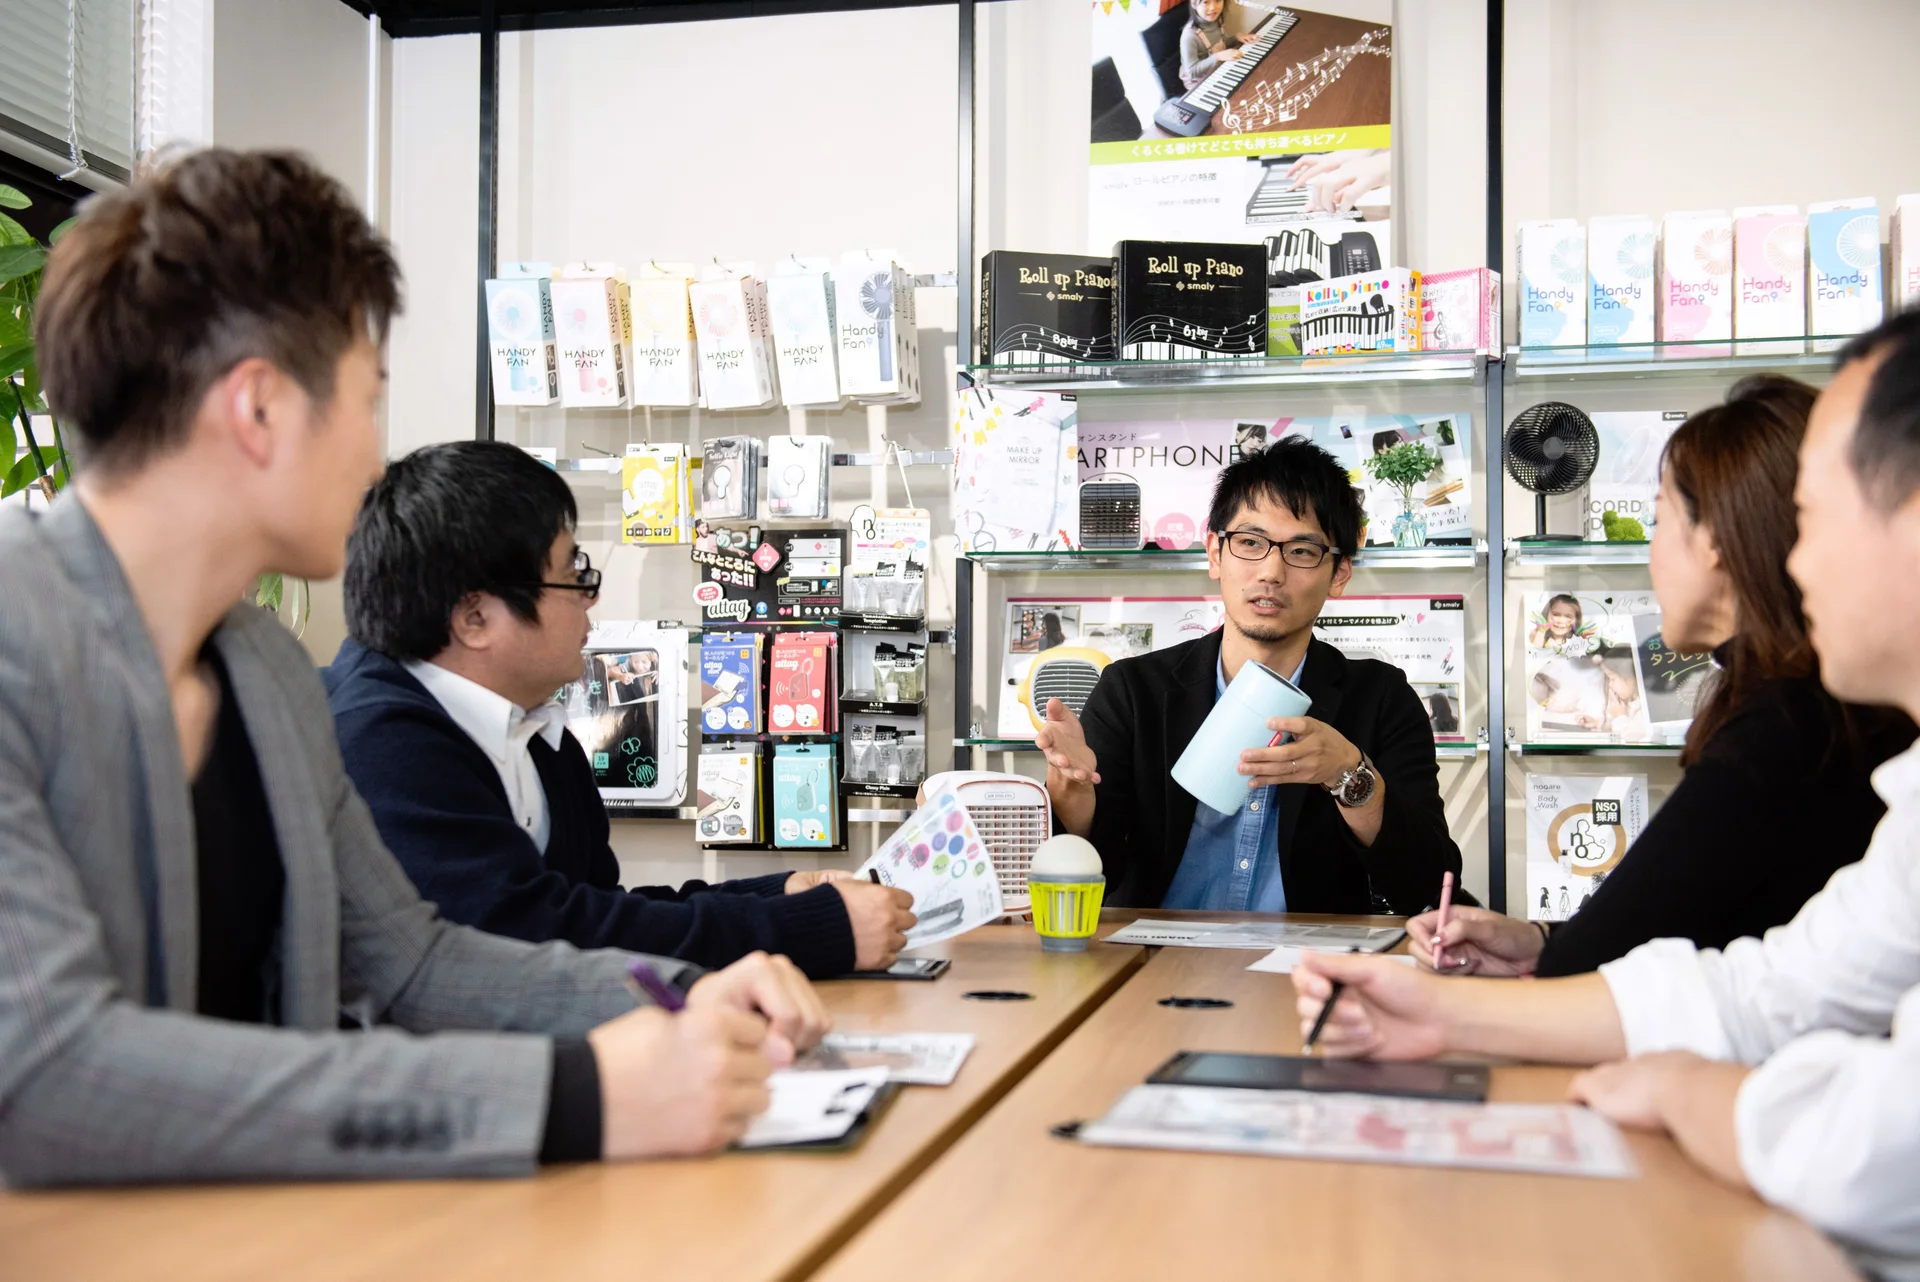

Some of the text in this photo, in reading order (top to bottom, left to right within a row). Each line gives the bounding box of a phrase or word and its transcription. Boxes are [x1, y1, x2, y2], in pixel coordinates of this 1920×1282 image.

[1147, 256, 1244, 280] Roll up Piano
[1019, 266, 1112, 291] Roll up Piano
[1743, 275, 1792, 293] Handy
[1817, 270, 1868, 288] Handy
[1187, 281, 1215, 292] smaly
[1594, 283, 1642, 299] Handy
[1670, 279, 1719, 297] Handy
[1057, 291, 1084, 302] smaly
[1528, 287, 1574, 304] Handy
[1743, 292, 1770, 304] Fan
[1817, 287, 1845, 301] Fan
[1594, 298, 1621, 311] Fan
[1670, 294, 1698, 307] Fan
[1528, 301, 1554, 313] Fan
[842, 322, 884, 339] Handy
[843, 338, 866, 350] Fan
[497, 348, 536, 356] HANDY
[565, 349, 605, 359] HANDY
[640, 348, 681, 357] HANDY
[707, 349, 745, 361] HANDY
[783, 345, 824, 356] HANDY
[507, 358, 528, 366] FAN
[575, 360, 597, 368] FAN
[649, 358, 672, 367] FAN
[717, 361, 738, 370] FAN
[793, 356, 817, 366] FAN
[1007, 446, 1043, 454] MAKE UP
[1009, 456, 1040, 465] MIRROR
[692, 550, 756, 574] こんなところに
[1537, 794, 1559, 802] Body
[1537, 801, 1559, 809] Wash
[1595, 802, 1618, 812] NSO
[1596, 812, 1618, 823] 採用
